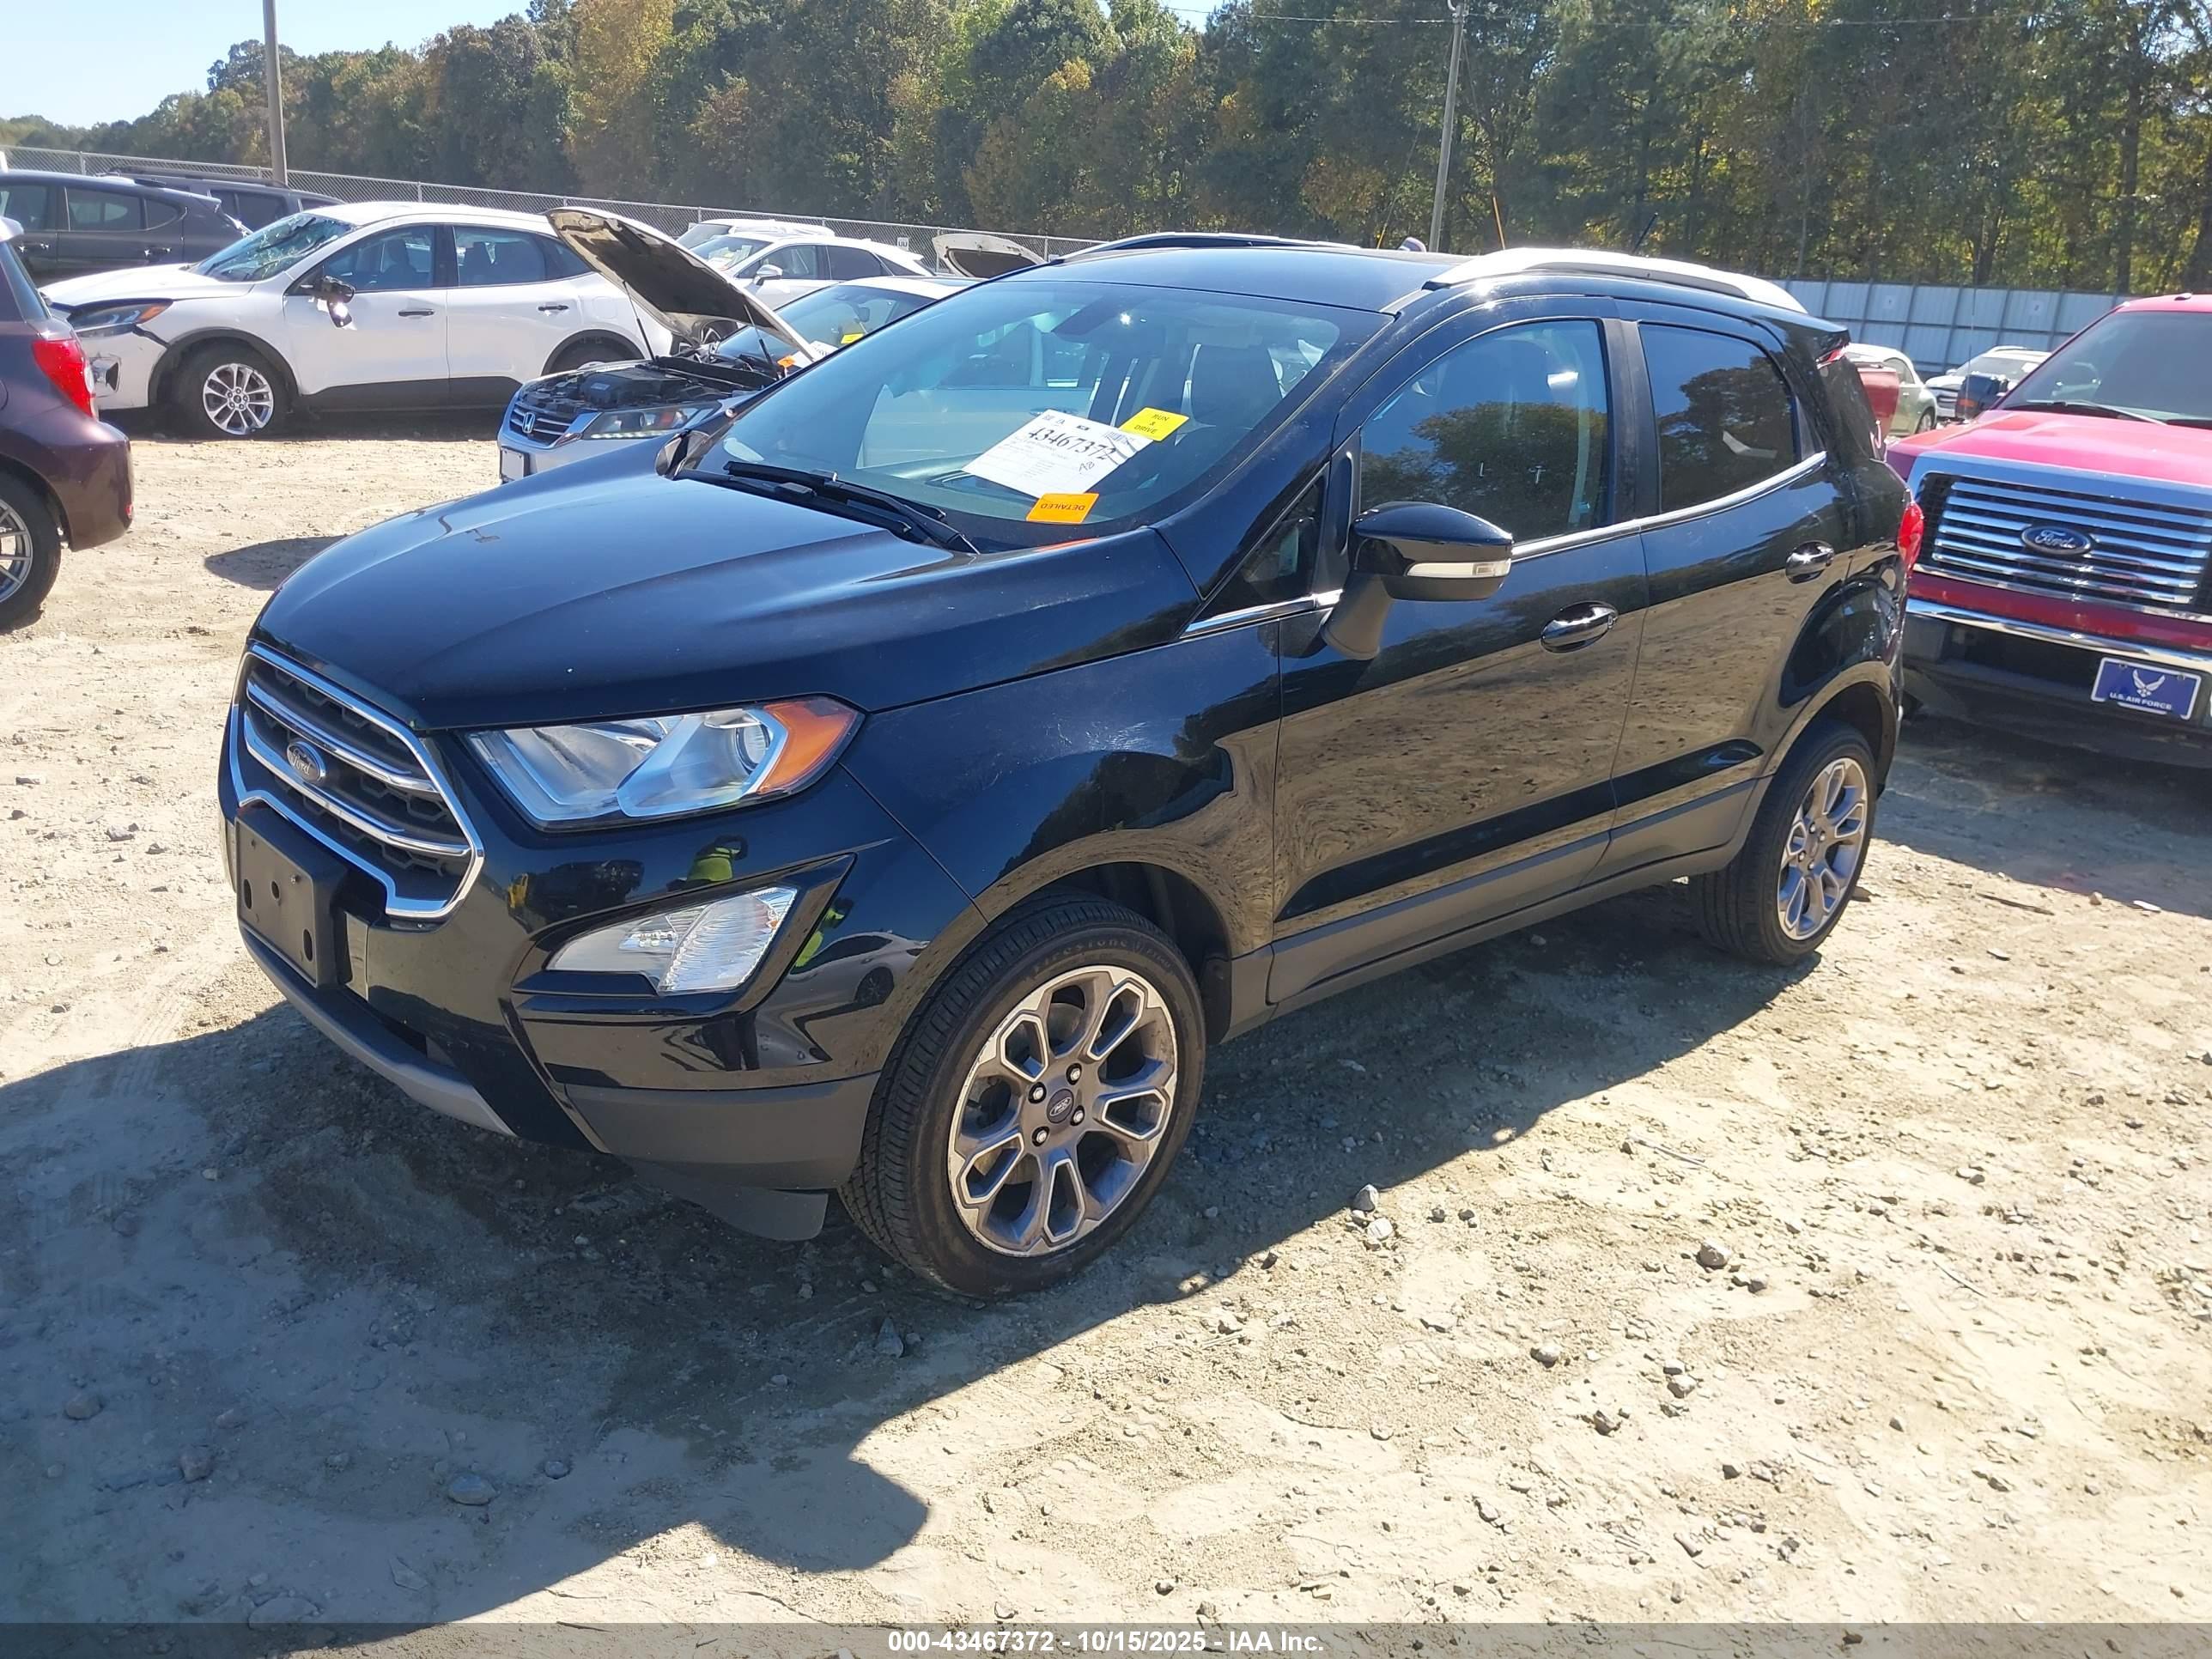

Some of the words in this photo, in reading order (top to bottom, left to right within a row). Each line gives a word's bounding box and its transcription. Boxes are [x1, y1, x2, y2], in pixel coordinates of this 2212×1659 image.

[1133, 424, 1158, 434] DRIVE
[1028, 427, 1116, 460] 43467372
[2034, 529, 2076, 550] Ford
[2109, 691, 2125, 701] U.S.
[2125, 696, 2142, 704] AIR
[2142, 699, 2172, 710] FORCE
[289, 748, 310, 775] Ford
